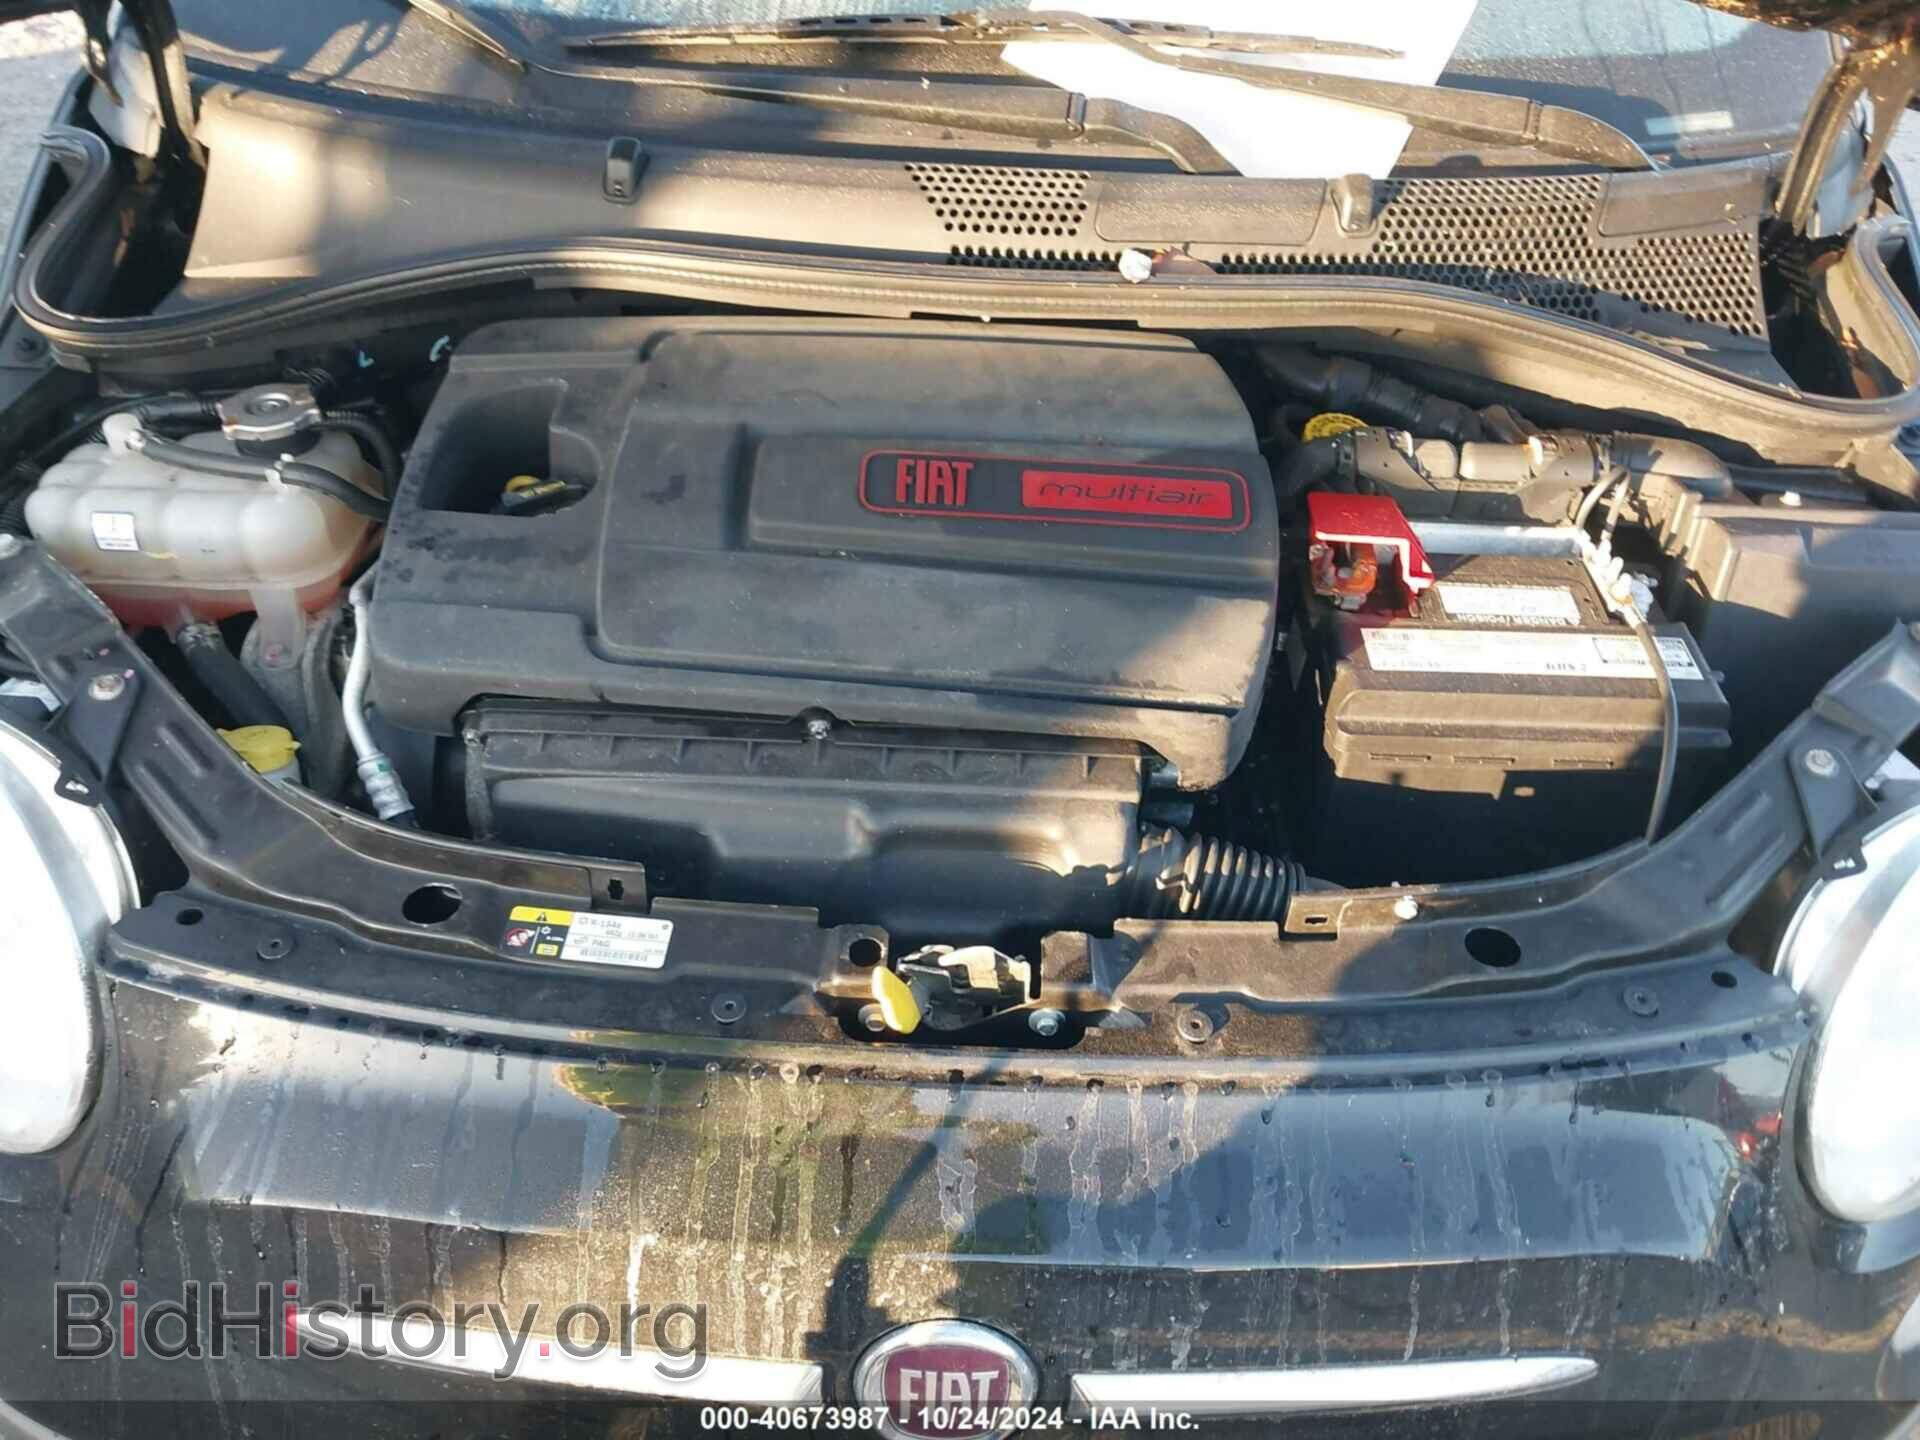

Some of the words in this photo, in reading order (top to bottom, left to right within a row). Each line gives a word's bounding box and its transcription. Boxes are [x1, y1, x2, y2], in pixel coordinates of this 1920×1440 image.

[895, 457, 976, 507] FIAT
[1039, 479, 1214, 505] multiair
[900, 1368, 1000, 1422] FIAT
